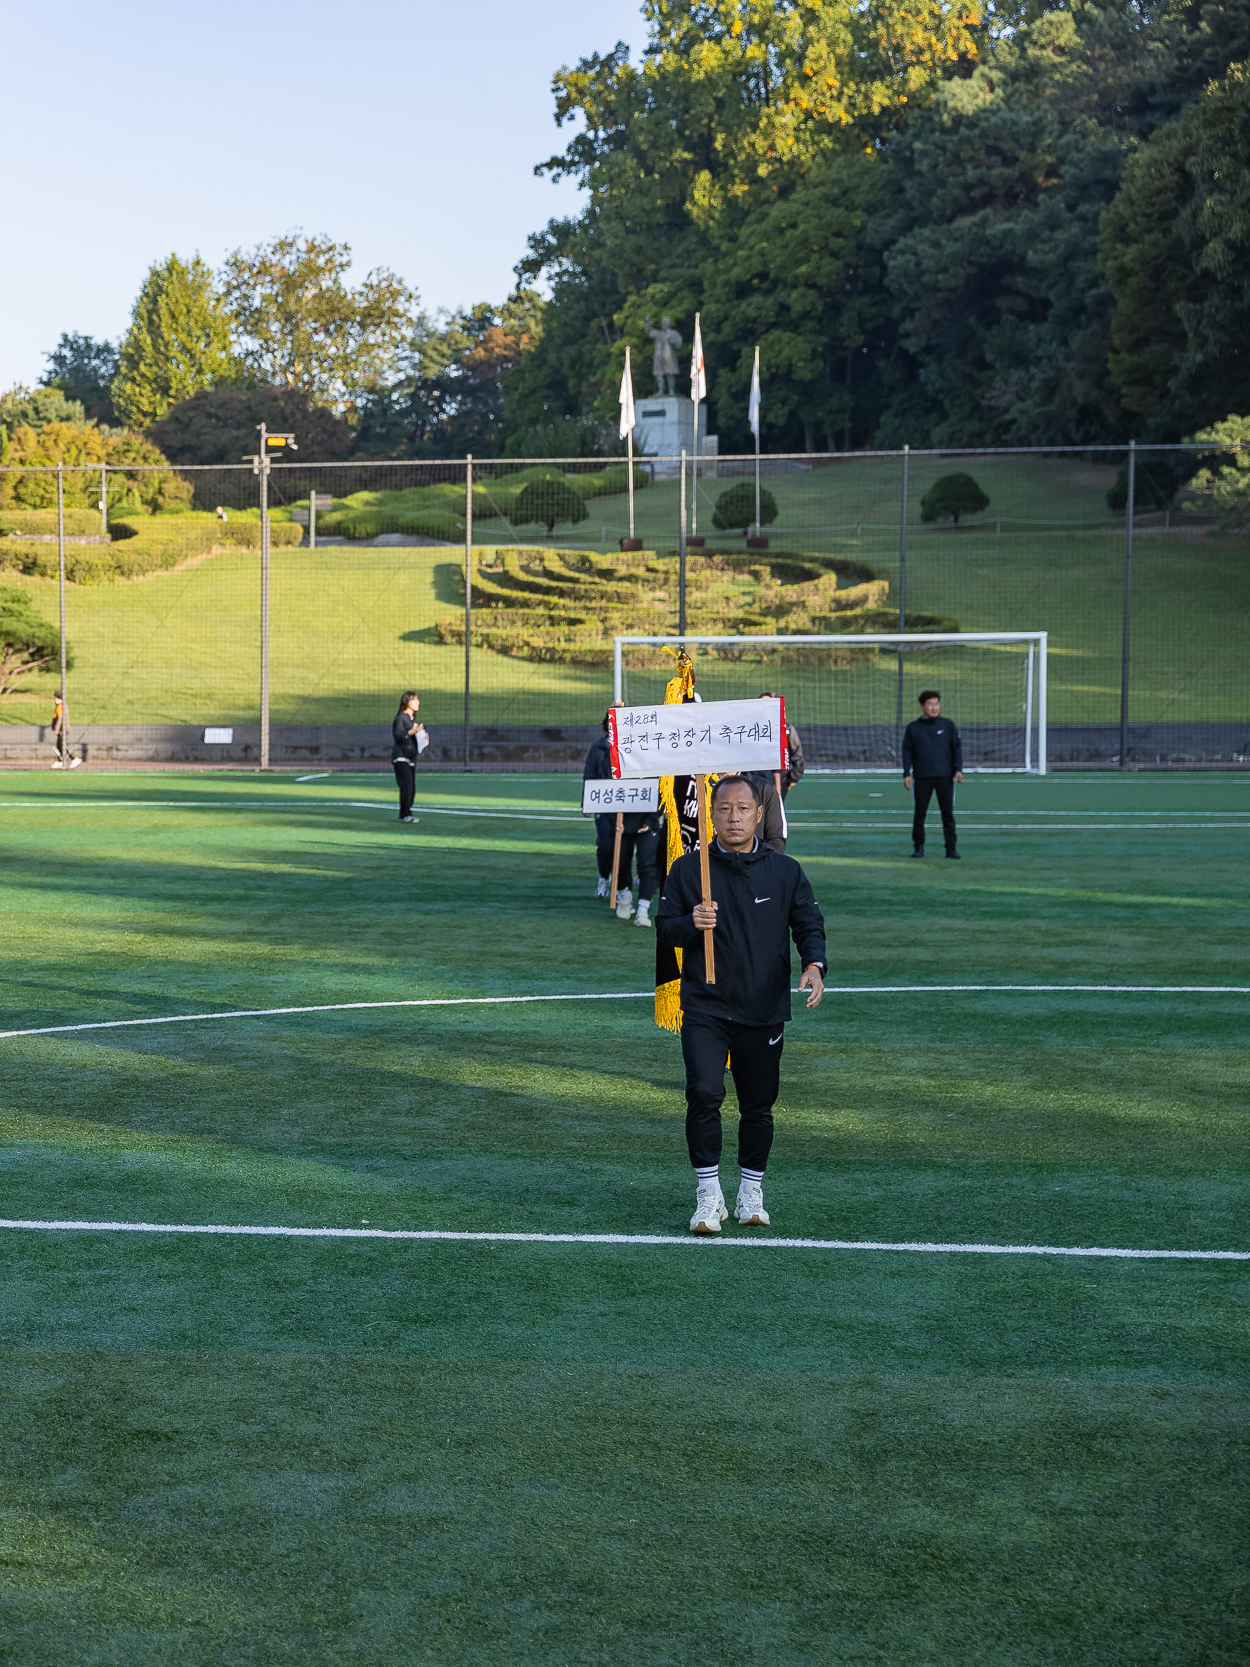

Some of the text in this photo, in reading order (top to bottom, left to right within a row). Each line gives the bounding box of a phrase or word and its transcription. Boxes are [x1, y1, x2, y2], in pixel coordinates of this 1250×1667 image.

[623, 711, 658, 728] 제28회
[719, 719, 773, 744] 축구대회
[590, 787, 652, 804] 여성축구회
